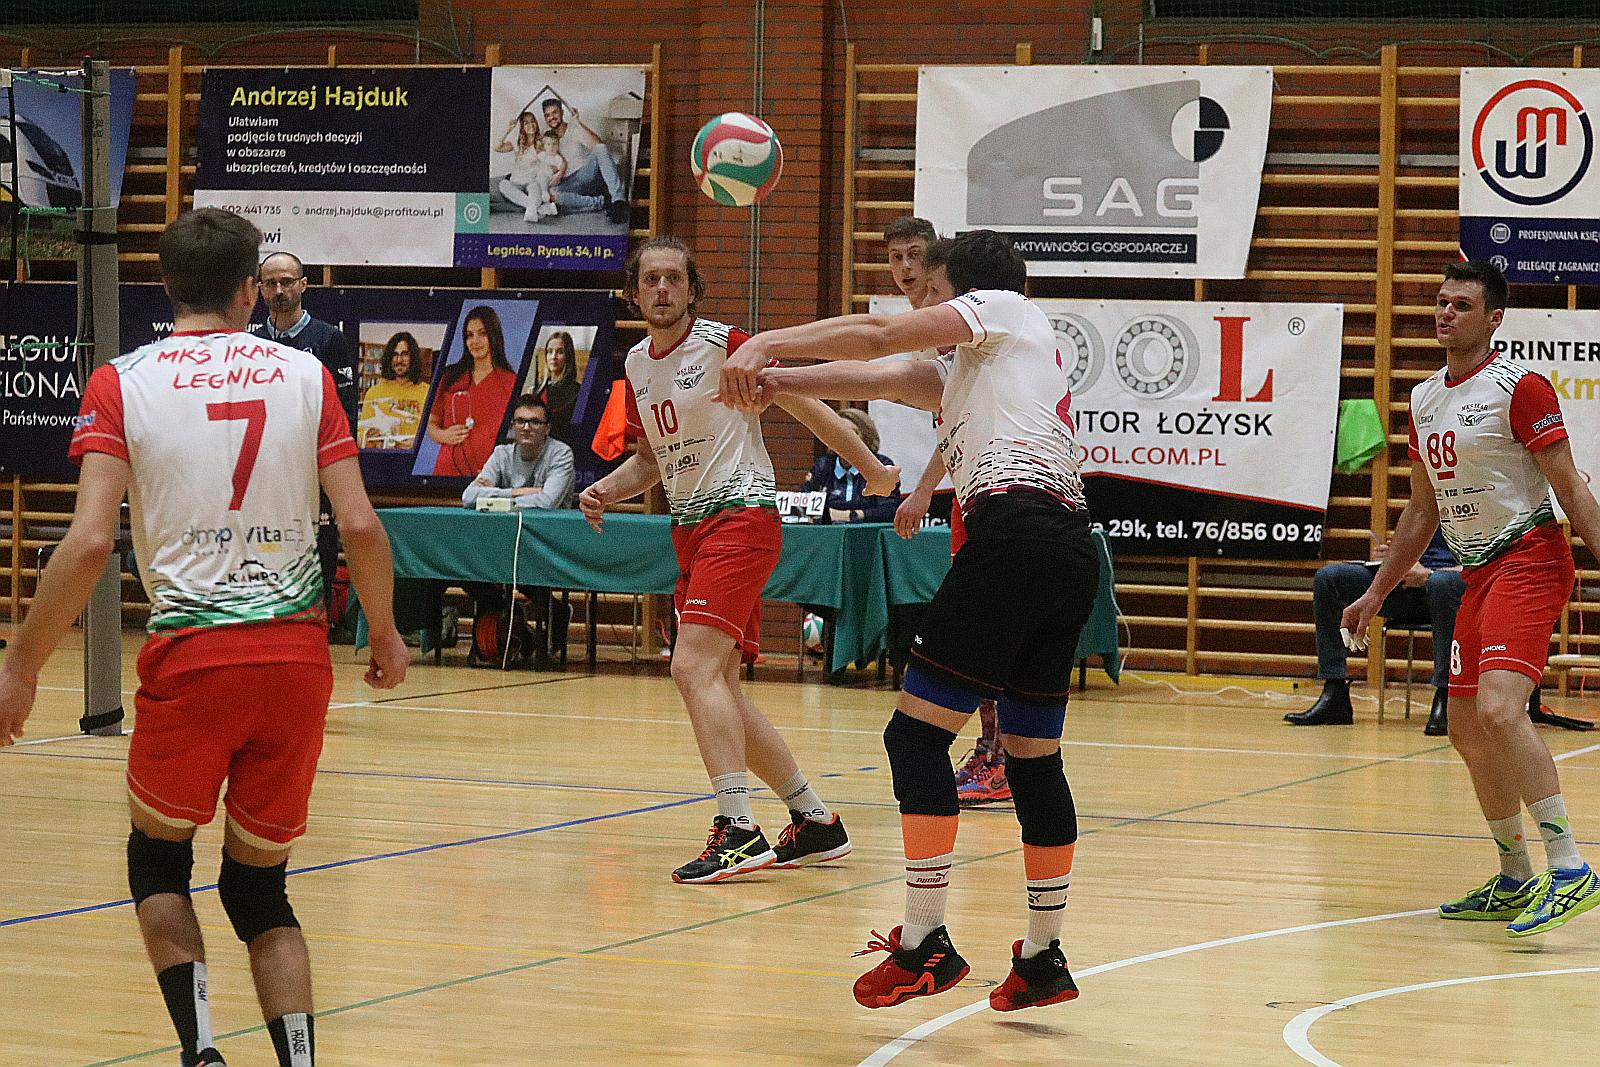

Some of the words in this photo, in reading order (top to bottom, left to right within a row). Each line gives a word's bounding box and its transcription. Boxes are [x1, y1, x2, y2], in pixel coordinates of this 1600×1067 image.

[230, 85, 317, 111] Andrzej
[325, 86, 409, 111] Hajduk
[229, 116, 279, 127] Ułatwiam
[227, 131, 276, 144] podjęcie
[277, 131, 323, 144] trudnych
[325, 132, 363, 144] decyzji
[226, 149, 236, 157] w
[238, 147, 287, 158] obszarze
[226, 162, 298, 175] ubezpieczeń,
[298, 162, 346, 175] kredytów
[353, 163, 427, 176] oszczędności
[1043, 176, 1199, 219] SAG
[244, 206, 262, 214] 441
[264, 206, 282, 215] 735
[304, 206, 444, 218] andrzej.hajduk@profitowi.pl
[1518, 230, 1579, 242] PROFESJONALNA
[487, 244, 535, 258] Legnica,
[537, 245, 573, 258] Rynek
[575, 245, 593, 258] 34,
[603, 247, 615, 259] p.
[1014, 240, 1090, 252] AKTYWNOŚCI
[1091, 241, 1188, 254] GOSPODARCZEJ
[1517, 261, 1557, 273] DELEGACJE
[157, 348, 212, 365] MKS
[224, 345, 289, 363] IKAR
[0, 371, 80, 399] LONA
[172, 367, 285, 390] LEGNICA
[650, 399, 679, 438] 10
[1157, 407, 1274, 437] ŁOŻYSK
[206, 399, 267, 511] 7
[1426, 430, 1458, 470] 88
[779, 496, 789, 513] 11
[810, 496, 823, 512] 12
[1108, 519, 1152, 541] 29k,
[1156, 520, 1188, 539] tel.
[1192, 519, 1268, 542] 76/856
[1272, 524, 1299, 542] 09
[1303, 524, 1323, 542] 26
